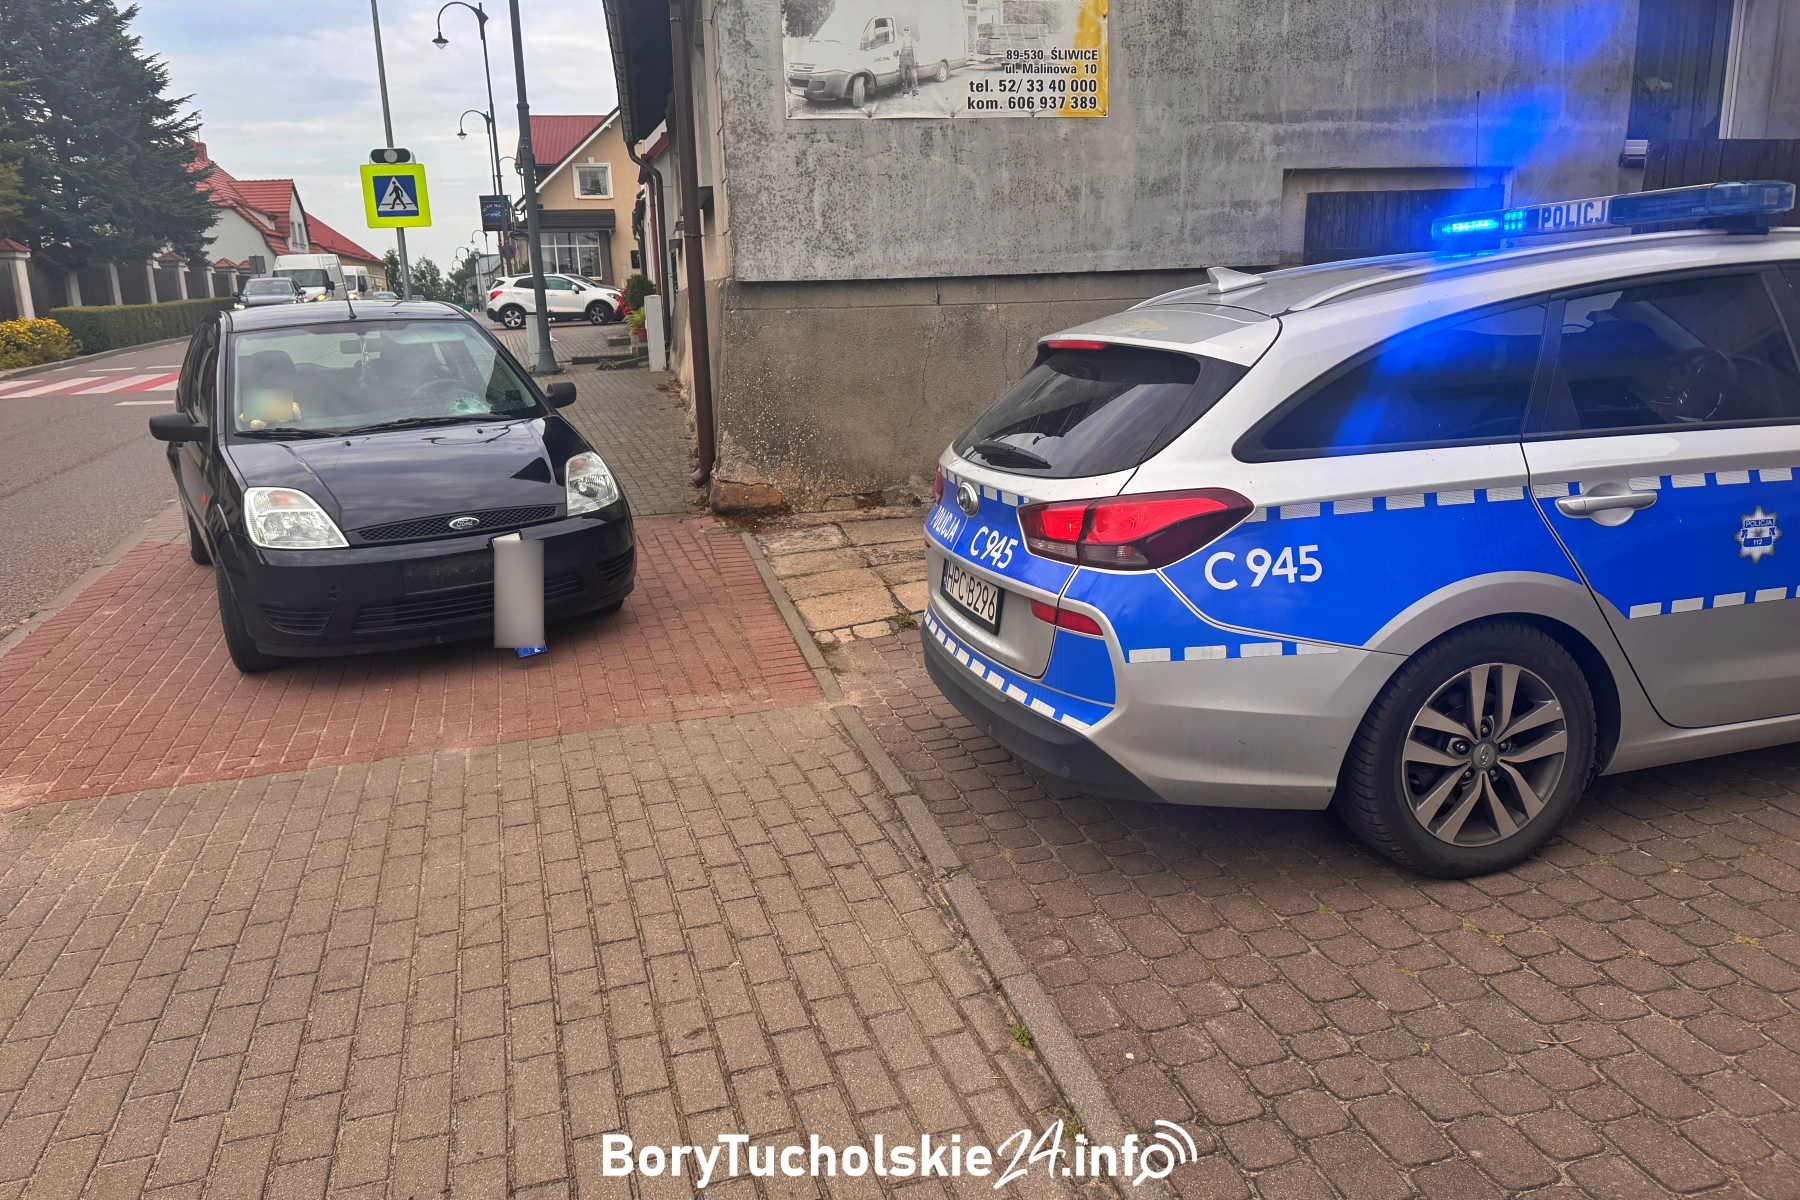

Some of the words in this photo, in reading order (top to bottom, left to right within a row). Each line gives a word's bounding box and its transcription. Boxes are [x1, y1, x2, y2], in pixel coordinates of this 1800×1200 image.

[1050, 46, 1098, 60] ŚLIWICE
[1005, 63, 1018, 74] ul.
[1022, 63, 1077, 74] Malinowa
[1084, 63, 1097, 74] 10
[969, 79, 993, 93] tel.
[998, 79, 1023, 94] 52/
[1026, 79, 1044, 93] 33
[1048, 79, 1066, 93] 40
[1070, 79, 1097, 93] 000
[967, 96, 1003, 110] kom.
[1008, 96, 1035, 110] 606
[1039, 96, 1066, 110] 937
[1070, 96, 1097, 110] 389
[1541, 200, 1606, 230] POLICJ
[456, 519, 474, 527] Ford
[930, 505, 961, 543] POLICJA
[1745, 520, 1773, 528] POLICJA
[970, 526, 989, 557] C
[980, 530, 1019, 569] 945
[1752, 538, 1763, 546] 112
[1204, 551, 1238, 590] C
[1245, 544, 1323, 588] 945
[947, 561, 967, 600] HPC
[966, 576, 997, 621] B296
